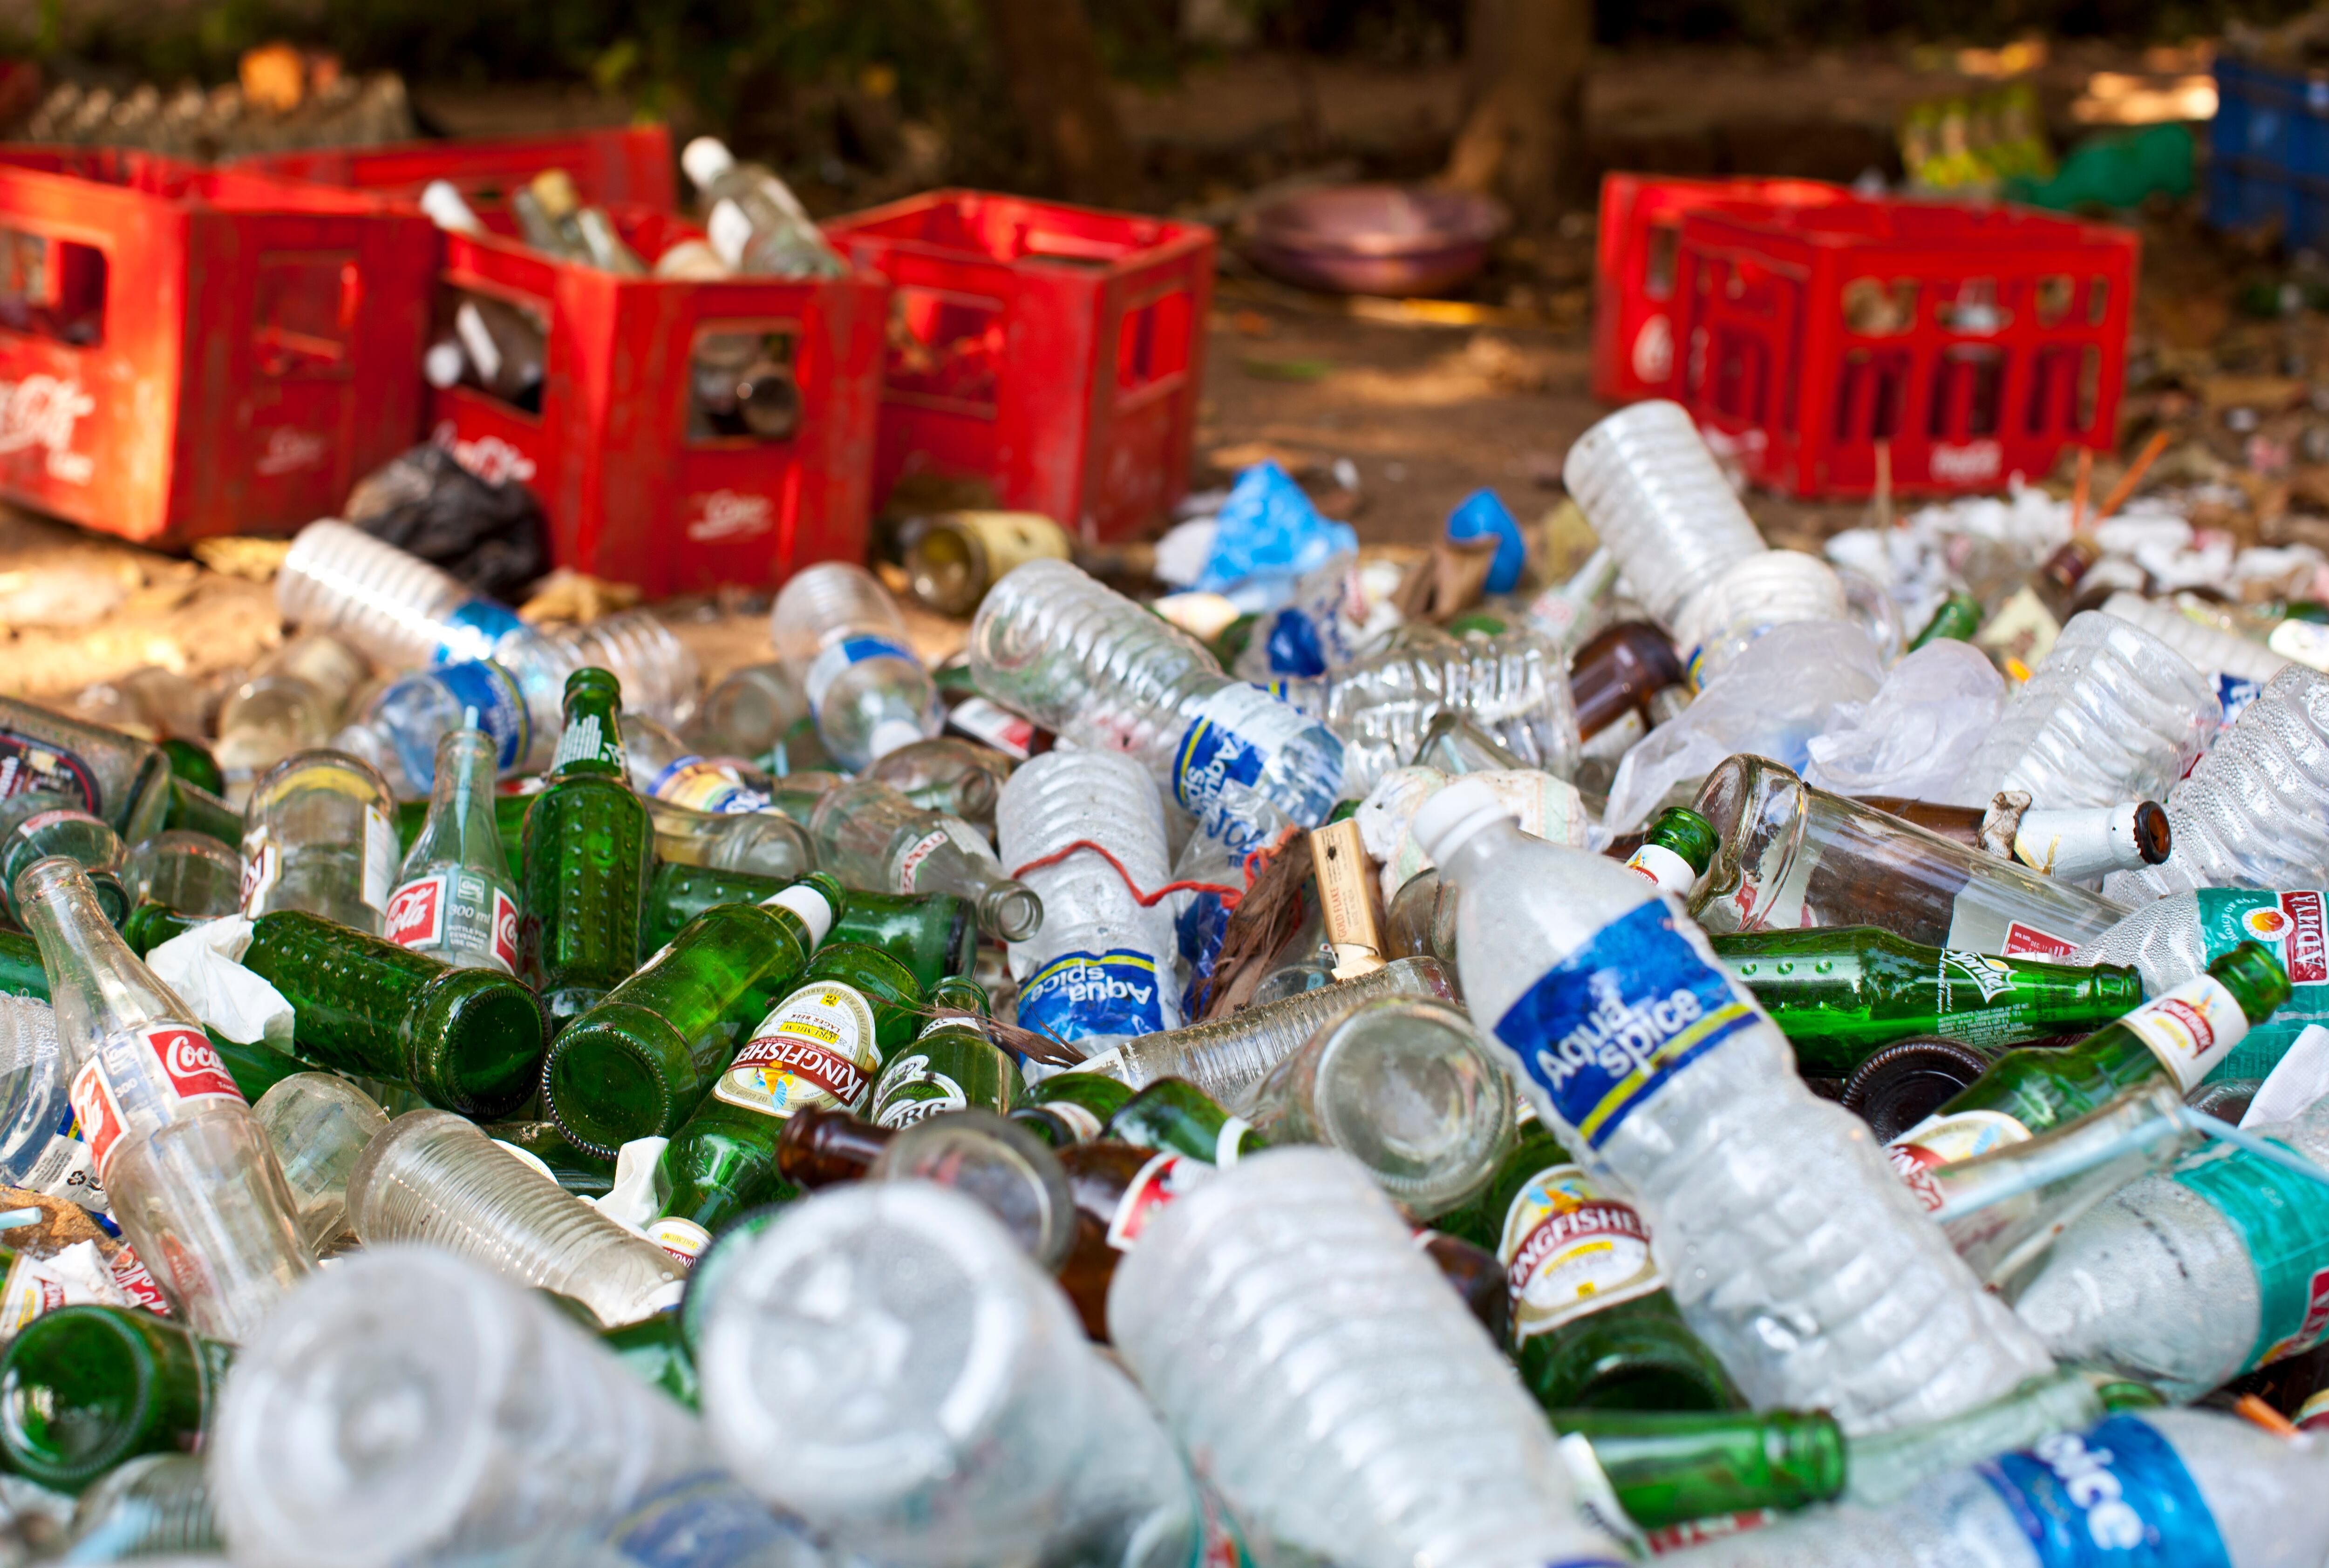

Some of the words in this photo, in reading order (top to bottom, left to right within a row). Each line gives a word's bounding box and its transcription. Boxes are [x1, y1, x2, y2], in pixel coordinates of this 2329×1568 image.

[1329, 886, 1342, 913] FLAKE
[449, 903, 474, 918] 300
[476, 911, 491, 924] ml
[1334, 912, 1348, 938] GOLD
[2288, 894, 2325, 969] ADITYA
[1030, 957, 1105, 1003] spice
[1946, 950, 2003, 990] Sprite
[1068, 976, 1152, 1005] Aqua
[790, 1012, 812, 1021] BEER
[813, 1015, 841, 1033] LAGER
[854, 1006, 867, 1032] FINEST
[783, 1023, 834, 1041] PREMIUM
[1536, 996, 1634, 1092] Aqua
[1596, 987, 1704, 1079] spice
[114, 1078, 138, 1099] 300
[1509, 1208, 1650, 1295] INGFISHE
